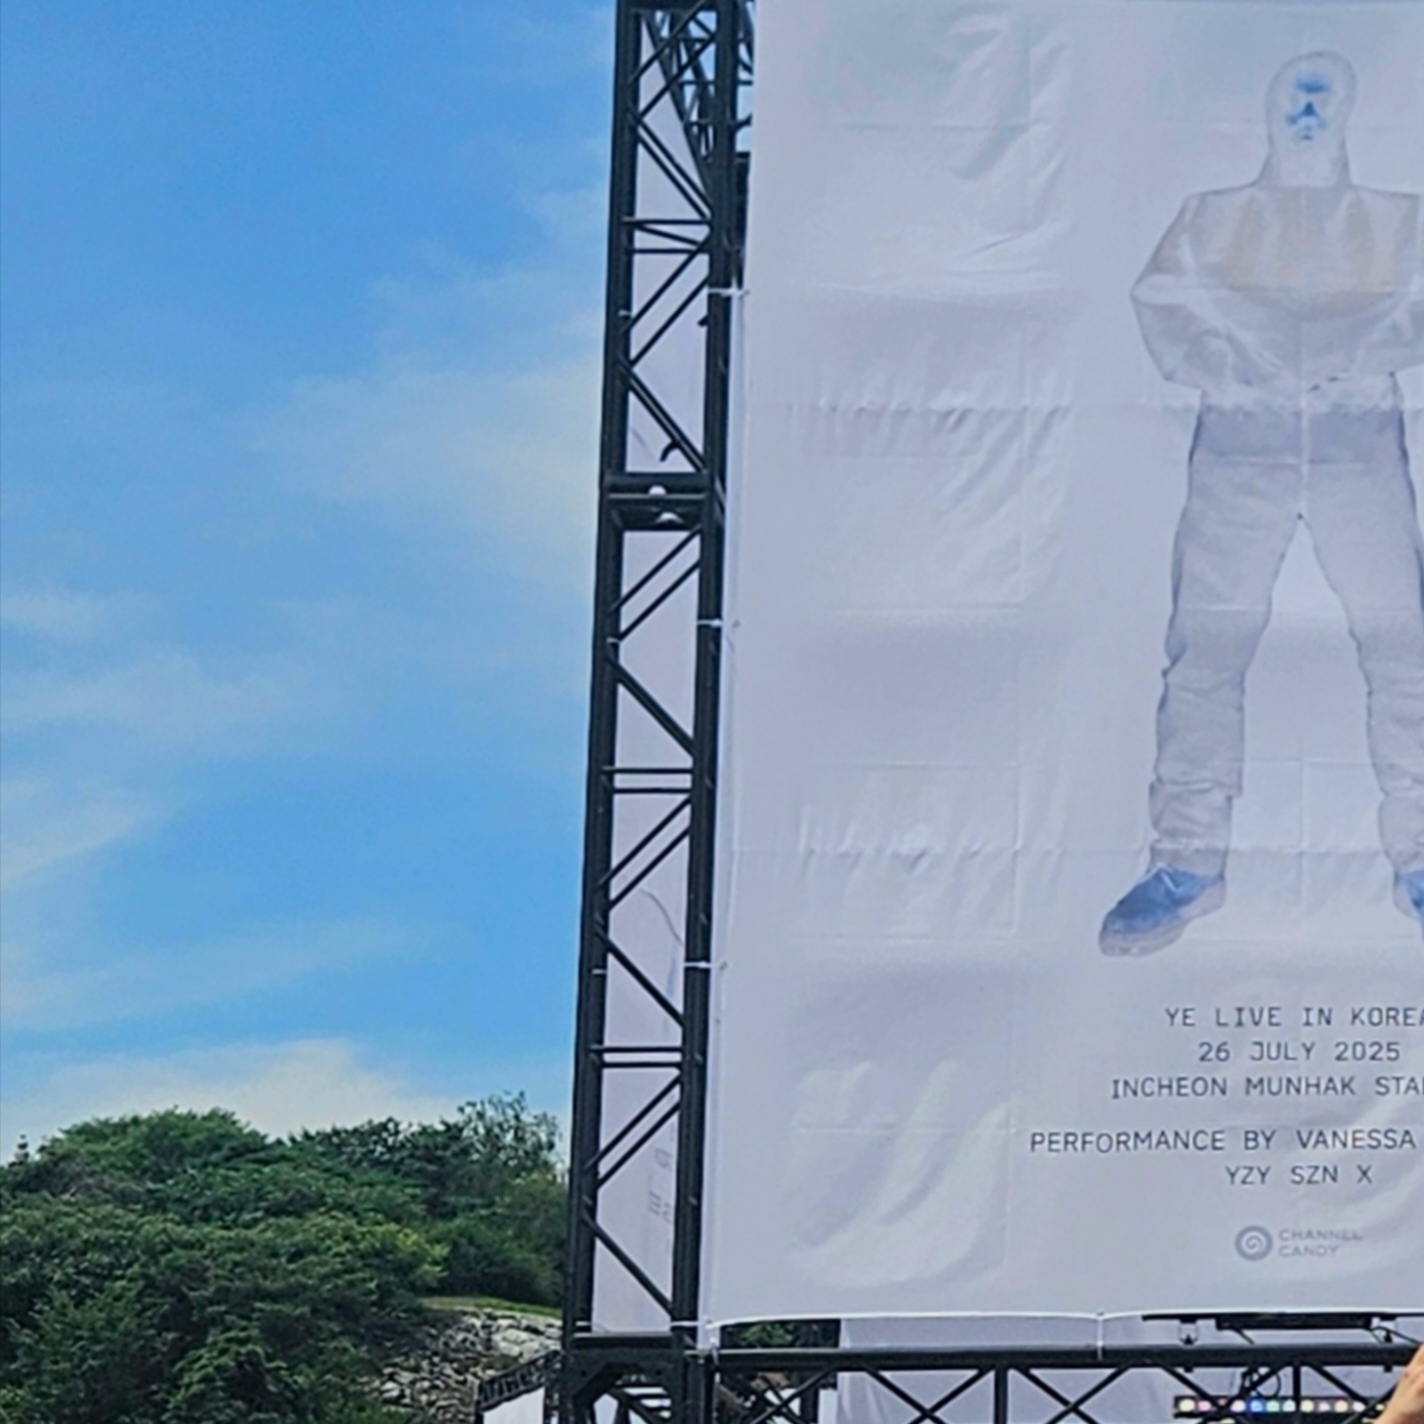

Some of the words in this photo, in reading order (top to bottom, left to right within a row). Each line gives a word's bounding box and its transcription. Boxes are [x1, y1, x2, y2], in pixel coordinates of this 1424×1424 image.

[1165, 1007, 1196, 1027] YE
[1215, 1006, 1281, 1028] LIVE
[1303, 1007, 1332, 1027] IN
[1198, 1041, 1230, 1062] 26
[1250, 1041, 1315, 1061] JULY
[1335, 1041, 1400, 1062] 2025
[1112, 1076, 1227, 1100] INCHEON
[1245, 1076, 1356, 1096] MUNHAK
[1030, 1129, 1224, 1154] PERFORMANCE
[1244, 1129, 1276, 1151] BY
[1296, 1128, 1417, 1150] VANESSA
[1225, 1166, 1271, 1185] YZY
[1290, 1165, 1338, 1185] SZN
[1357, 1164, 1372, 1184] X
[1278, 1228, 1365, 1242] CHANNEL
[1278, 1244, 1341, 1258] CANDY
